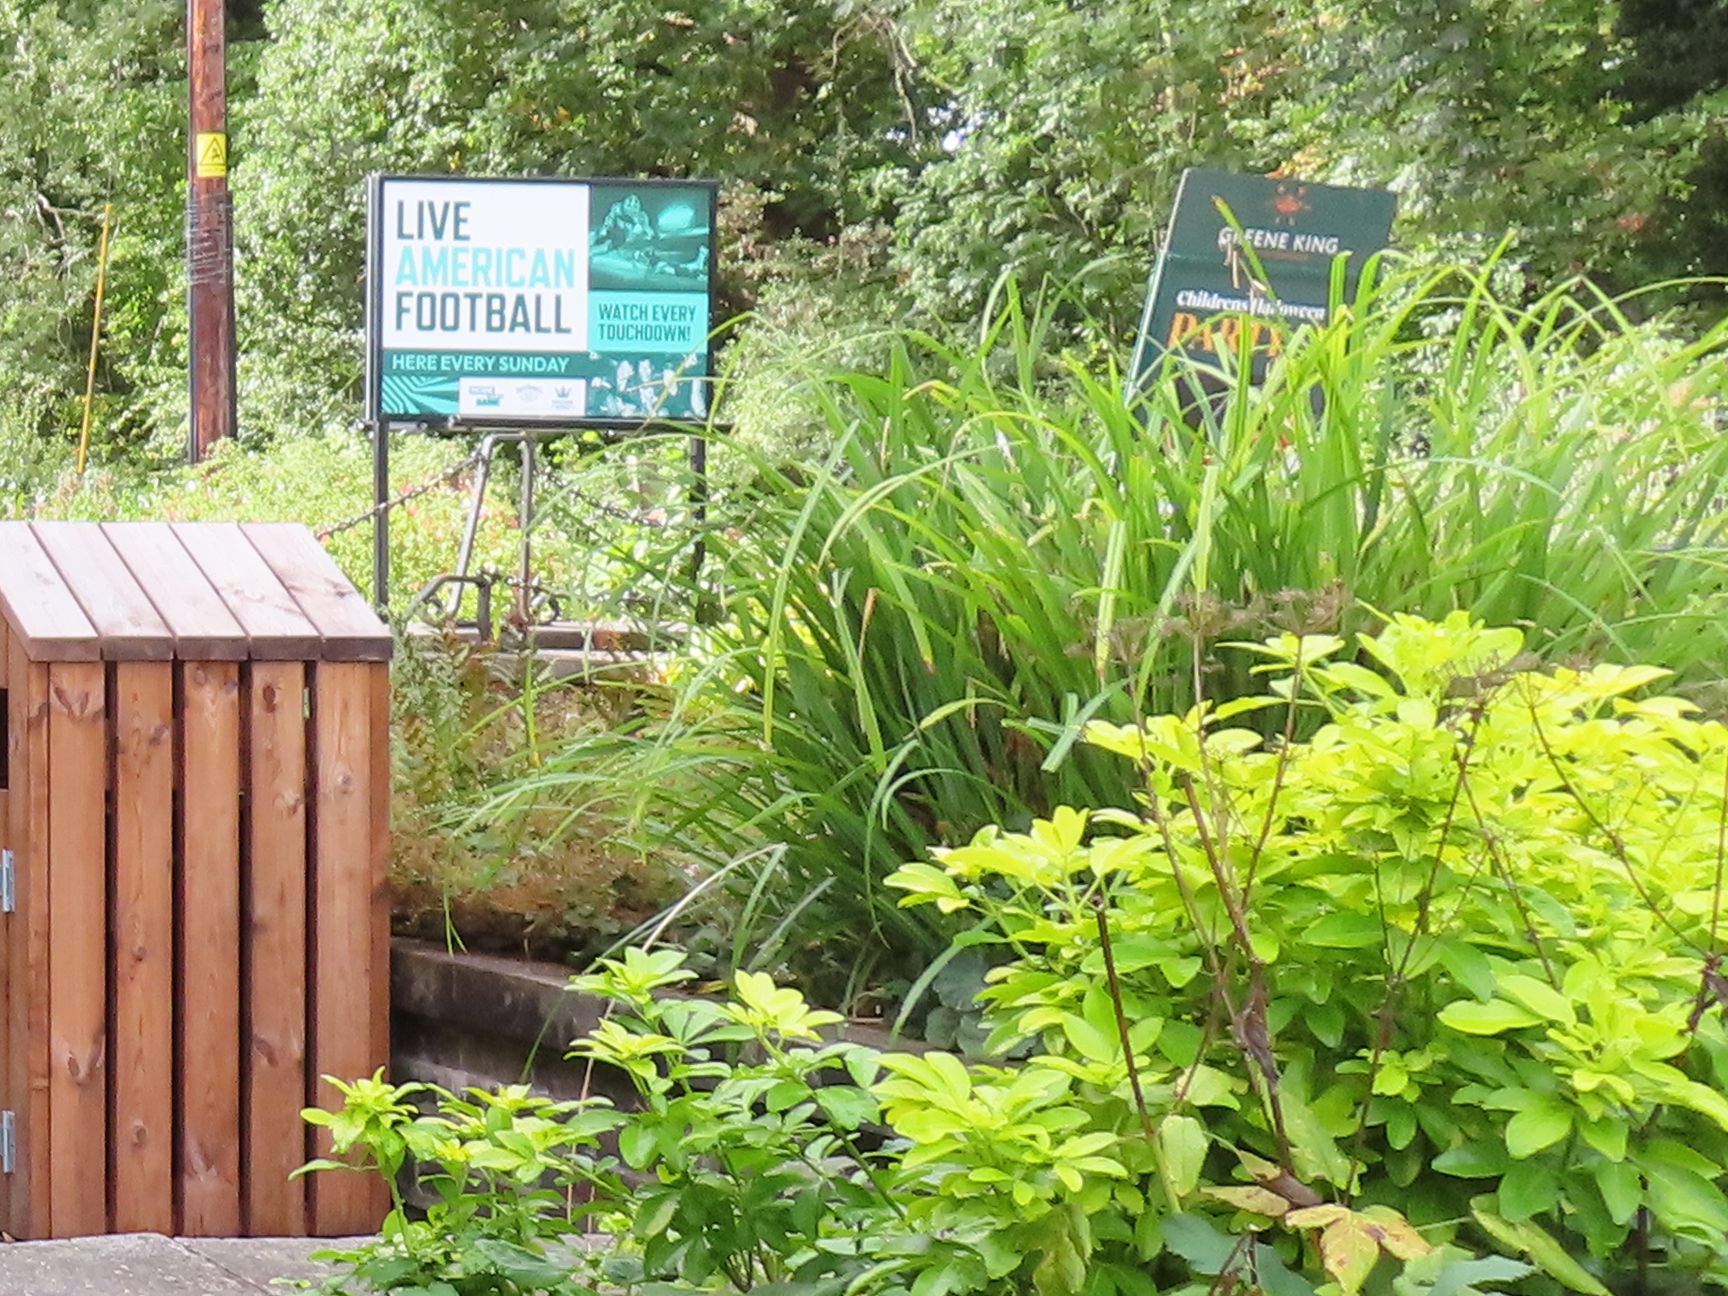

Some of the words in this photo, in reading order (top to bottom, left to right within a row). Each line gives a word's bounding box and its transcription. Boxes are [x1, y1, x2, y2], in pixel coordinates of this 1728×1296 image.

[396, 200, 471, 241] LIVE
[1293, 234, 1340, 254] KING
[395, 247, 575, 289] AMERICAN
[1176, 289, 1248, 312] Childrens
[395, 292, 572, 334] FOOTBALL
[598, 303, 649, 322] WATCH
[652, 304, 696, 323] EVERY
[598, 323, 692, 343] TOUCHDOWN!
[392, 354, 438, 371] HERE
[441, 355, 495, 372] EVERY
[499, 356, 570, 373] SUNDAY
